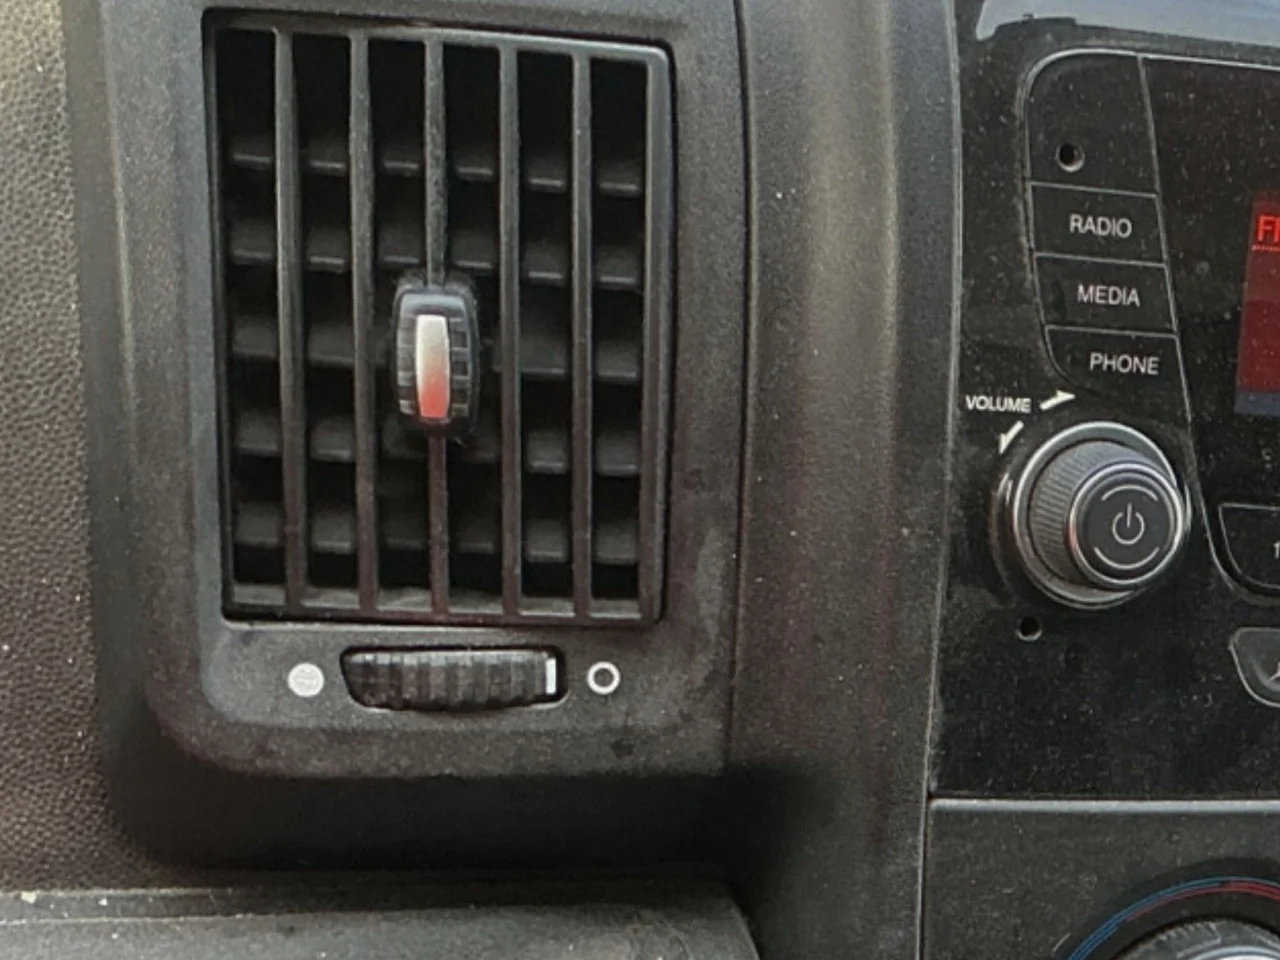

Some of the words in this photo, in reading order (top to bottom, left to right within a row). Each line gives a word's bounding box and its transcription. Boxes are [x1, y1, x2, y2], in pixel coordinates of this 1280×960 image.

[1069, 214, 1132, 238] RADIO
[1077, 284, 1140, 307] MEDIA
[1089, 352, 1160, 375] PHONE
[965, 394, 1032, 413] VOLUME
[1273, 541, 1280, 559] 1
